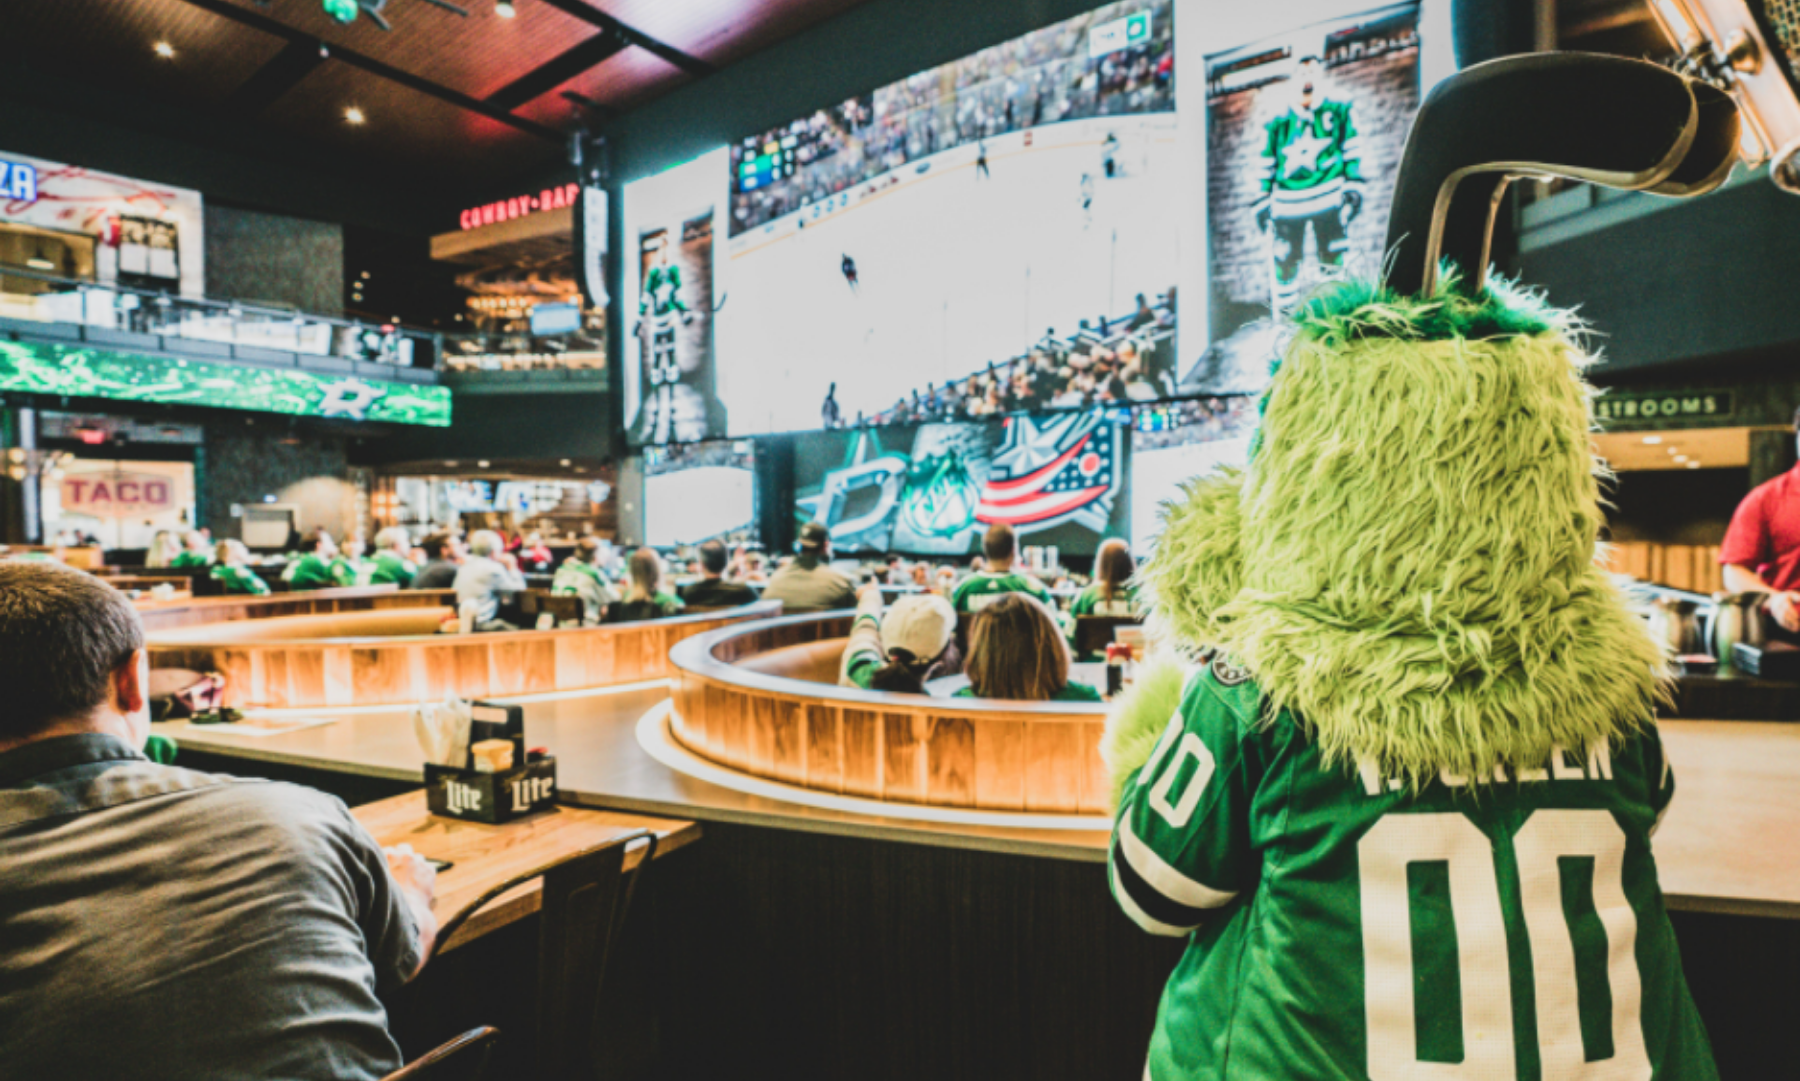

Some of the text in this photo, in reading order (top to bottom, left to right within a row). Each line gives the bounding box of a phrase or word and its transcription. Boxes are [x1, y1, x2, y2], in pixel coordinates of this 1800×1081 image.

[460, 194, 531, 231] COWBOY
[1597, 396, 1717, 418] STROOMS
[64, 479, 169, 504] TACO
[445, 779, 482, 816] Lite
[511, 776, 554, 812] Lite
[1356, 807, 1654, 1081] 00
